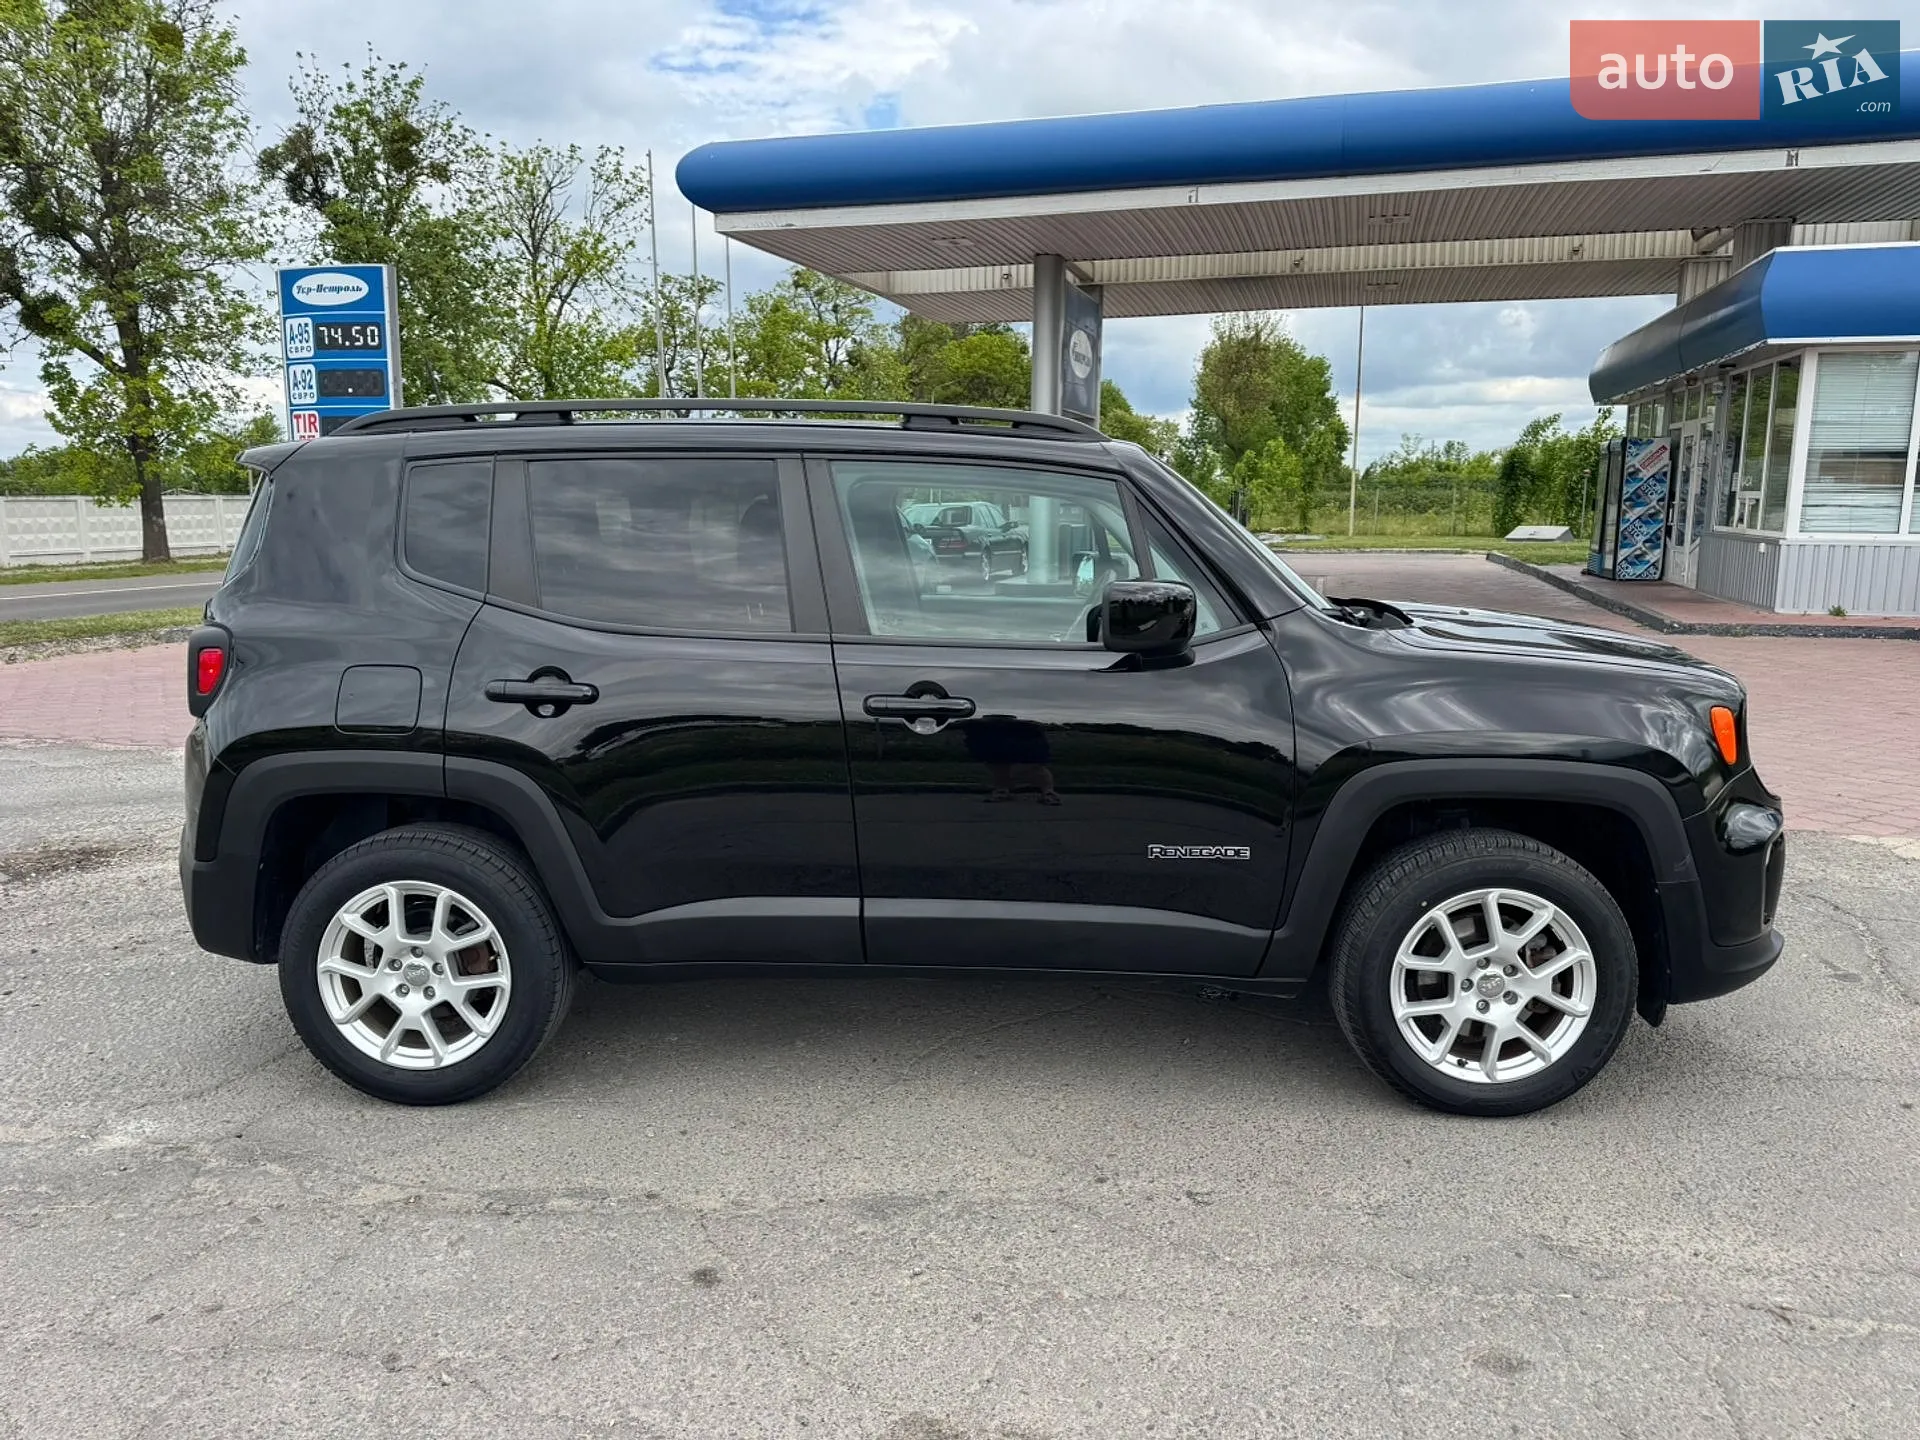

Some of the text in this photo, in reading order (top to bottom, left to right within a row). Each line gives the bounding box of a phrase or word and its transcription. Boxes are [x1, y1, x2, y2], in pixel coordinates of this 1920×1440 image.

[318, 326, 379, 346] 74.50
[293, 413, 318, 433] TIR
[1148, 844, 1250, 860] RENEGADE
